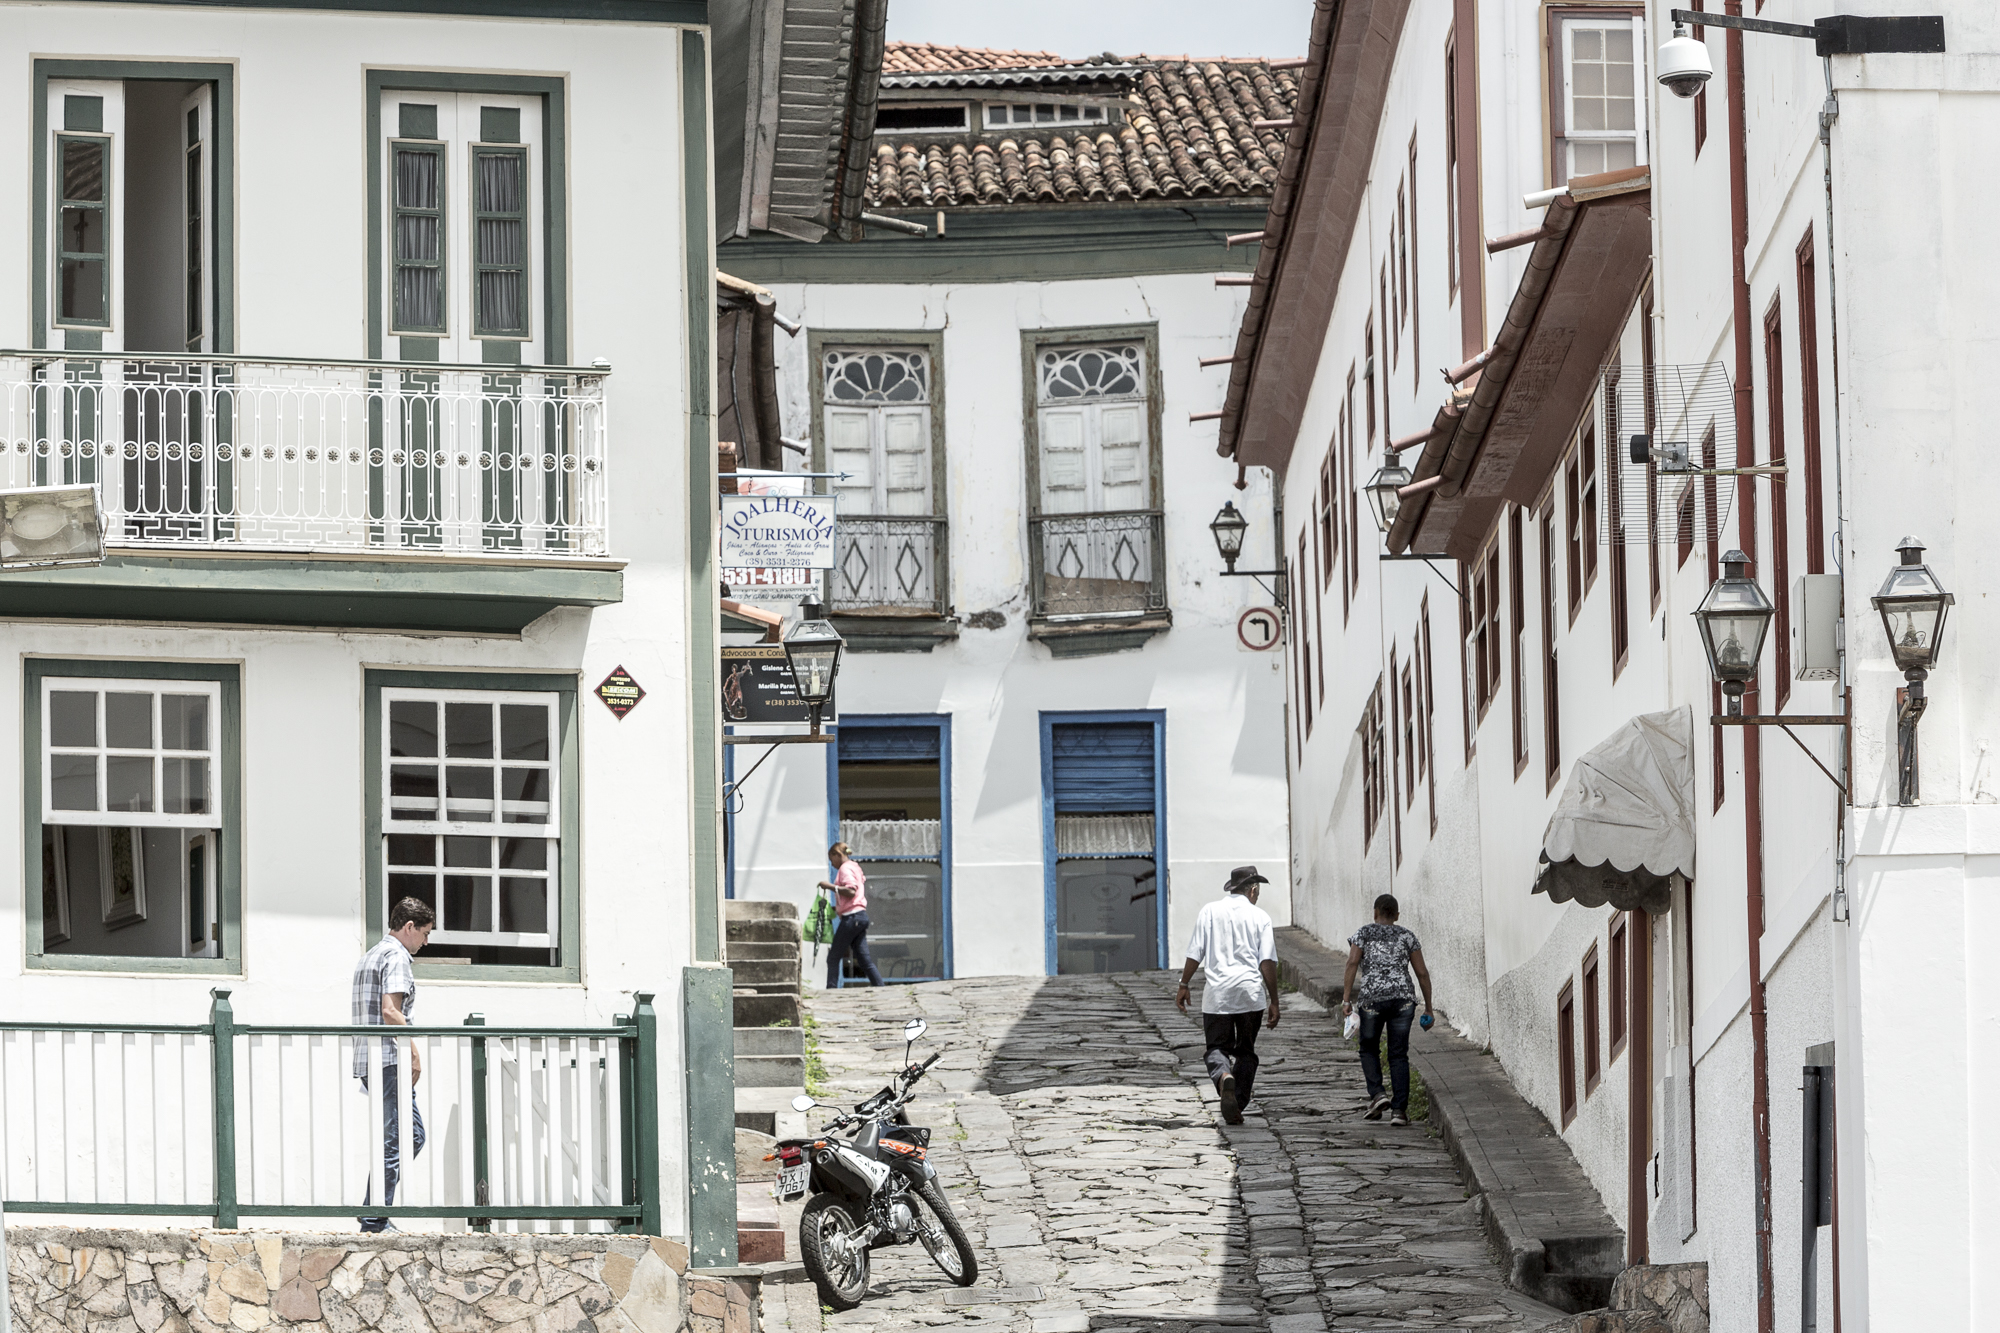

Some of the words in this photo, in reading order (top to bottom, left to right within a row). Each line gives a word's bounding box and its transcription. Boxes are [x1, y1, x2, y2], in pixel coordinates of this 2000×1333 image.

[725, 497, 833, 539] JOALHERIA
[741, 528, 819, 541] TURISMO
[739, 549, 754, 557] Coco
[766, 558, 811, 566] 3531-2376
[771, 699, 785, 707] (38)
[779, 1180, 804, 1194] 7067
